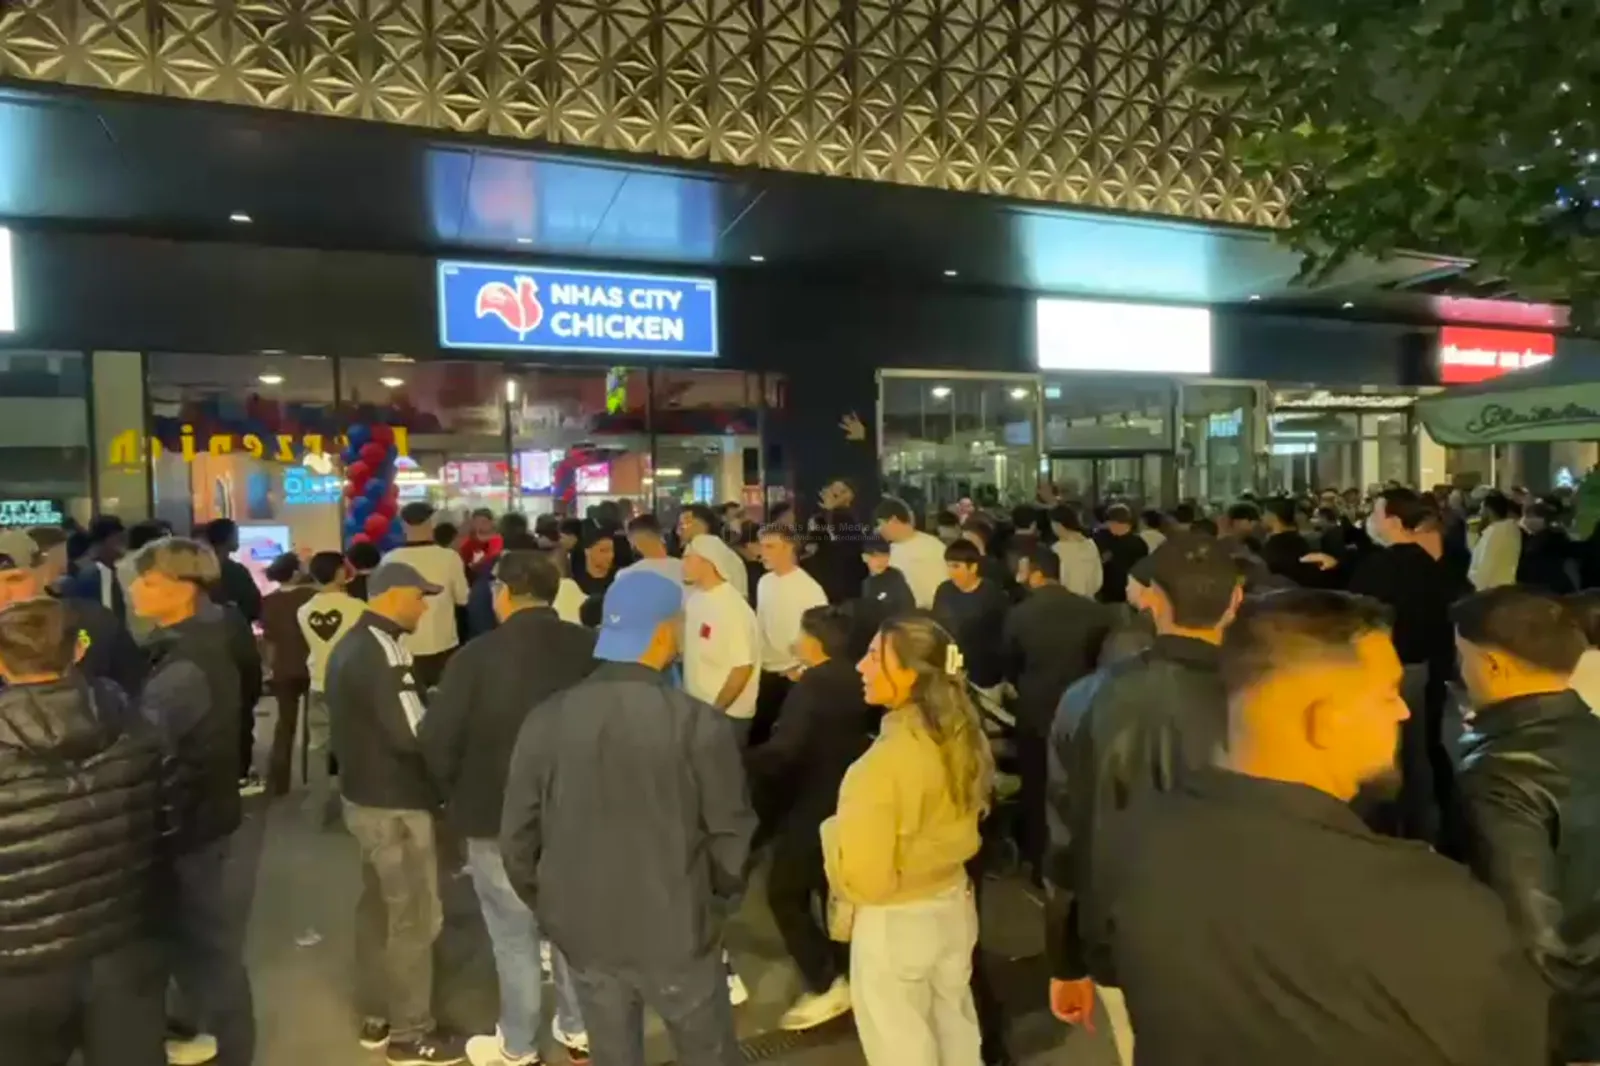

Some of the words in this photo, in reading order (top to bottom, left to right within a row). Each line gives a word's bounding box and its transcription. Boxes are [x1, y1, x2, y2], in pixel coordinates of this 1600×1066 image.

[550, 283, 623, 308] NHAS
[629, 288, 682, 310] CITY
[550, 313, 685, 341] CHICKEN
